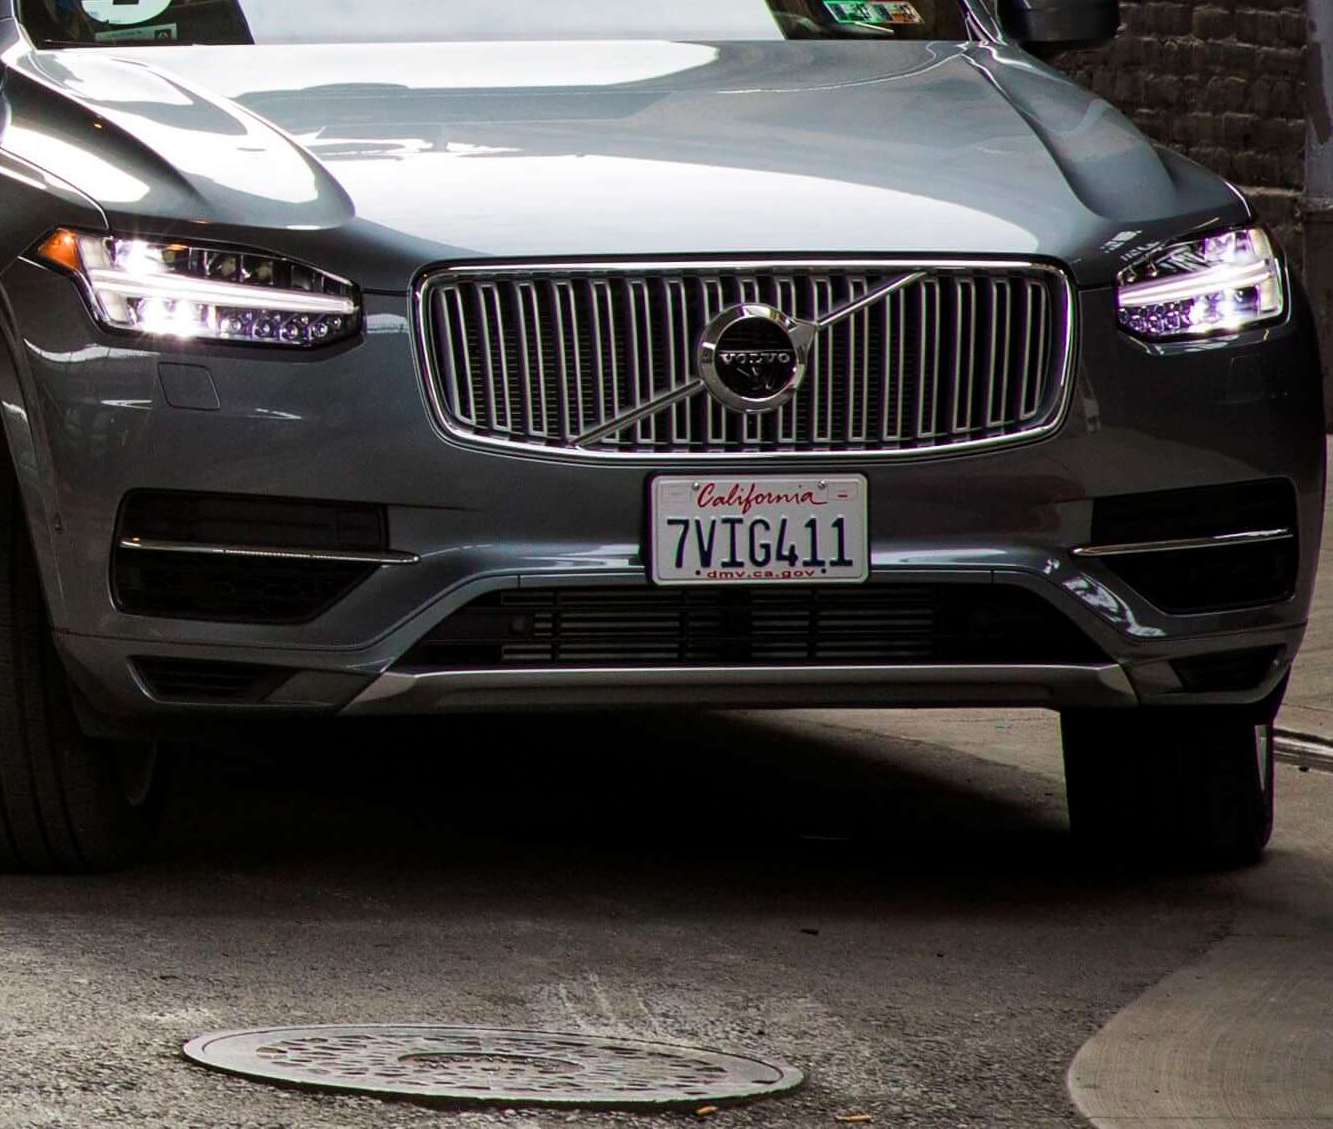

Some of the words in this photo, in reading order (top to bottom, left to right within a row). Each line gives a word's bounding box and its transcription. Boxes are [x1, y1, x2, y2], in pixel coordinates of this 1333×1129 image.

[697, 482, 828, 514] California
[666, 517, 854, 568] 7VIG411
[706, 568, 816, 579] dmv.ca.gov
